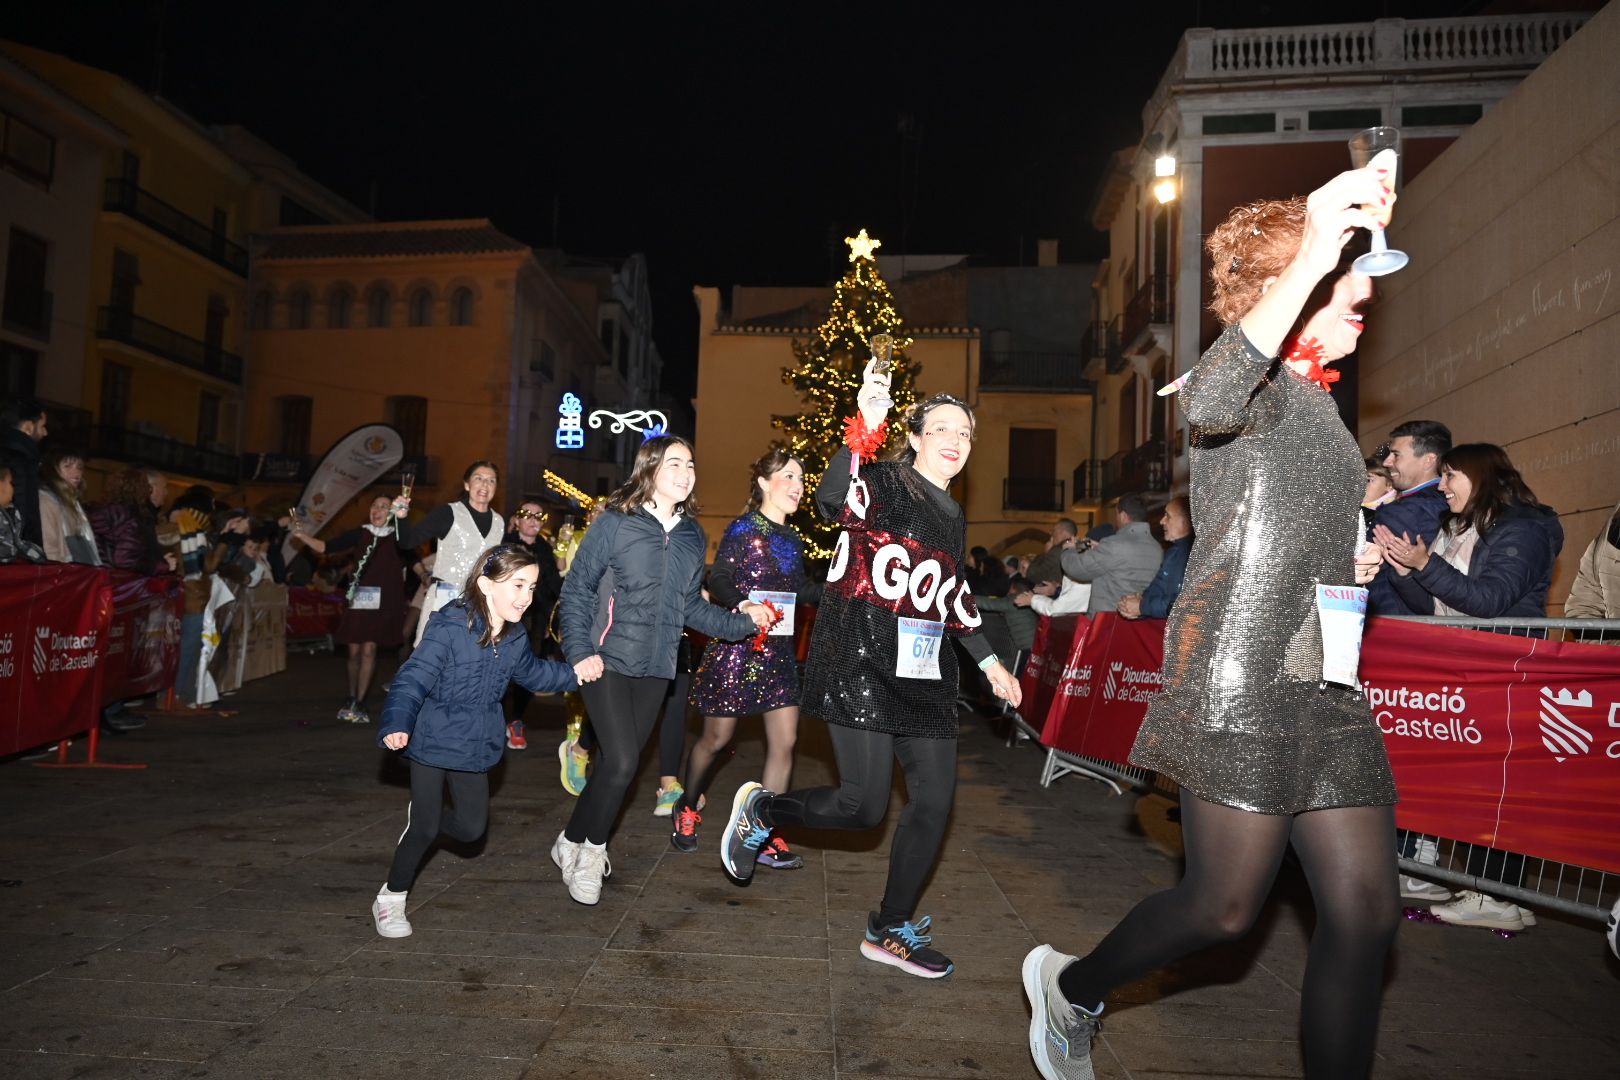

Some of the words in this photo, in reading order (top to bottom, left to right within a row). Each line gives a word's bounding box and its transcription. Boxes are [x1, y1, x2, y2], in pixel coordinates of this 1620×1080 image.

[51, 630, 97, 651] Diputació
[912, 636, 936, 659] 674
[1363, 681, 1466, 714] iputació
[1375, 710, 1482, 744] Castelló
